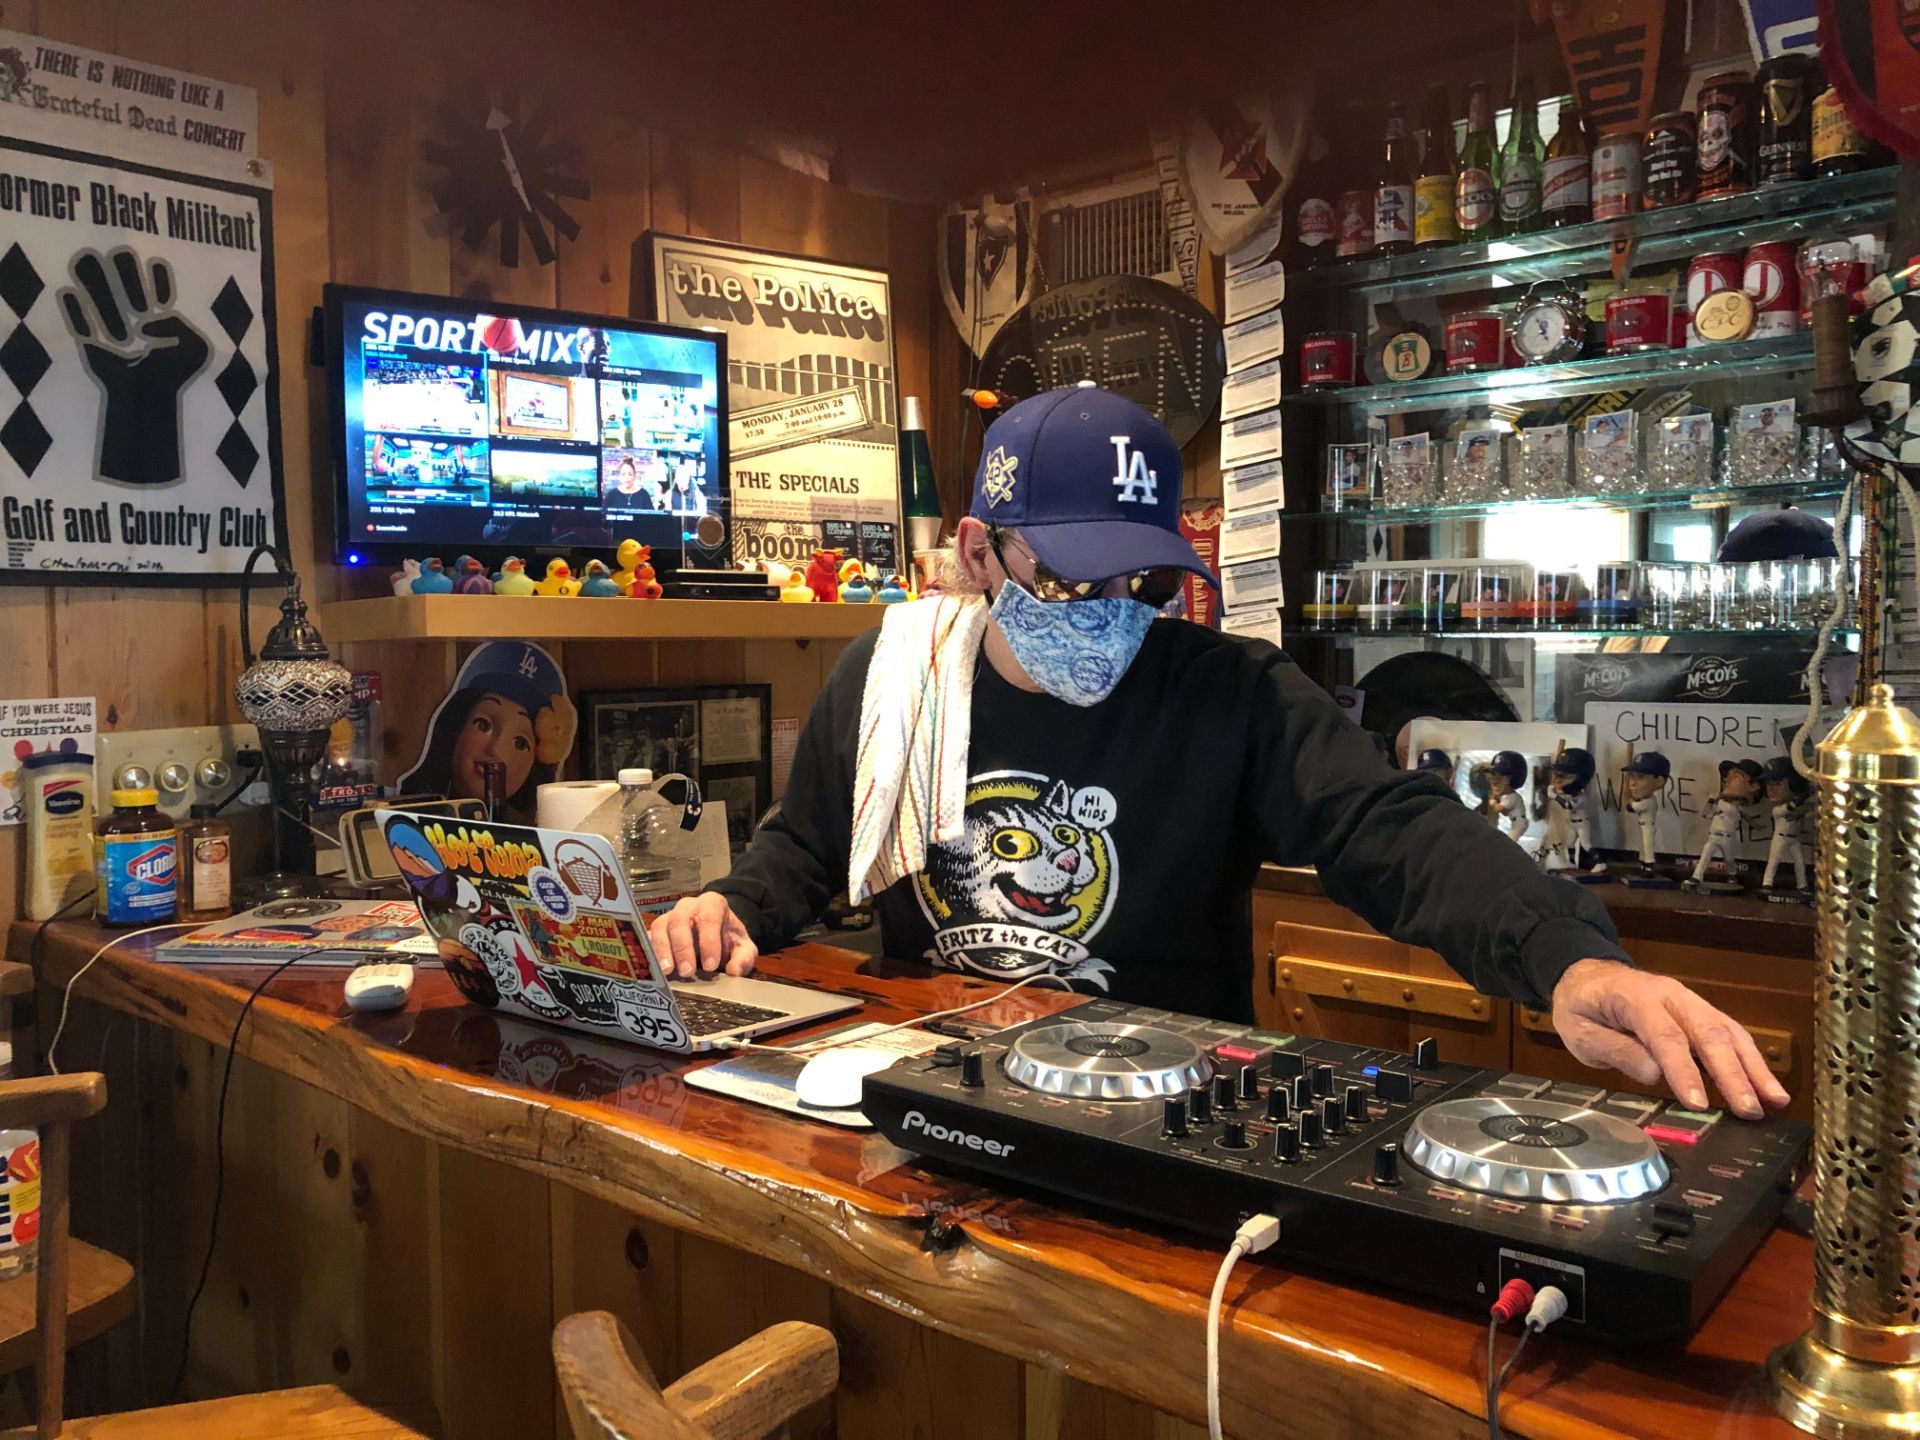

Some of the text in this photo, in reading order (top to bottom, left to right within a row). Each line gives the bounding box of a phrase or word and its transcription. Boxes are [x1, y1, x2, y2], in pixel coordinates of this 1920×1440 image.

[34, 47, 224, 111] THERE IS NOTHING LIKE A
[32, 85, 246, 152] Grateful Dead CONCERT
[0, 173, 257, 252] ormer Black Militant
[668, 262, 874, 320] the Police
[361, 312, 577, 365] SPORT MIX
[741, 398, 844, 429] MONDAY, JANUARY 28
[736, 471, 860, 494] THE SPECIALS
[1110, 436, 1158, 504] LA
[2, 496, 267, 554] Golf and Country Club
[742, 526, 820, 561] boom
[519, 646, 538, 679] LA
[12, 704, 30, 717] YOU
[33, 703, 60, 715] WERE
[63, 702, 92, 716] JESUS
[0, 724, 92, 738] CHRISTMAS
[1084, 794, 1100, 806] HI
[1596, 772, 1698, 816] WRE
[1079, 806, 1107, 822] KIDS
[136, 852, 177, 880] CLORO
[423, 822, 543, 879] Hot Tuna
[578, 926, 607, 937] 2018
[589, 917, 612, 928] MAN
[589, 941, 622, 957] ROBOT
[939, 927, 1076, 958] FRITZ the CAT
[571, 983, 595, 1005] SUB
[612, 988, 666, 1008] CALIFORNIA
[625, 1011, 678, 1043] 395
[901, 1110, 1015, 1158] Pioneer
